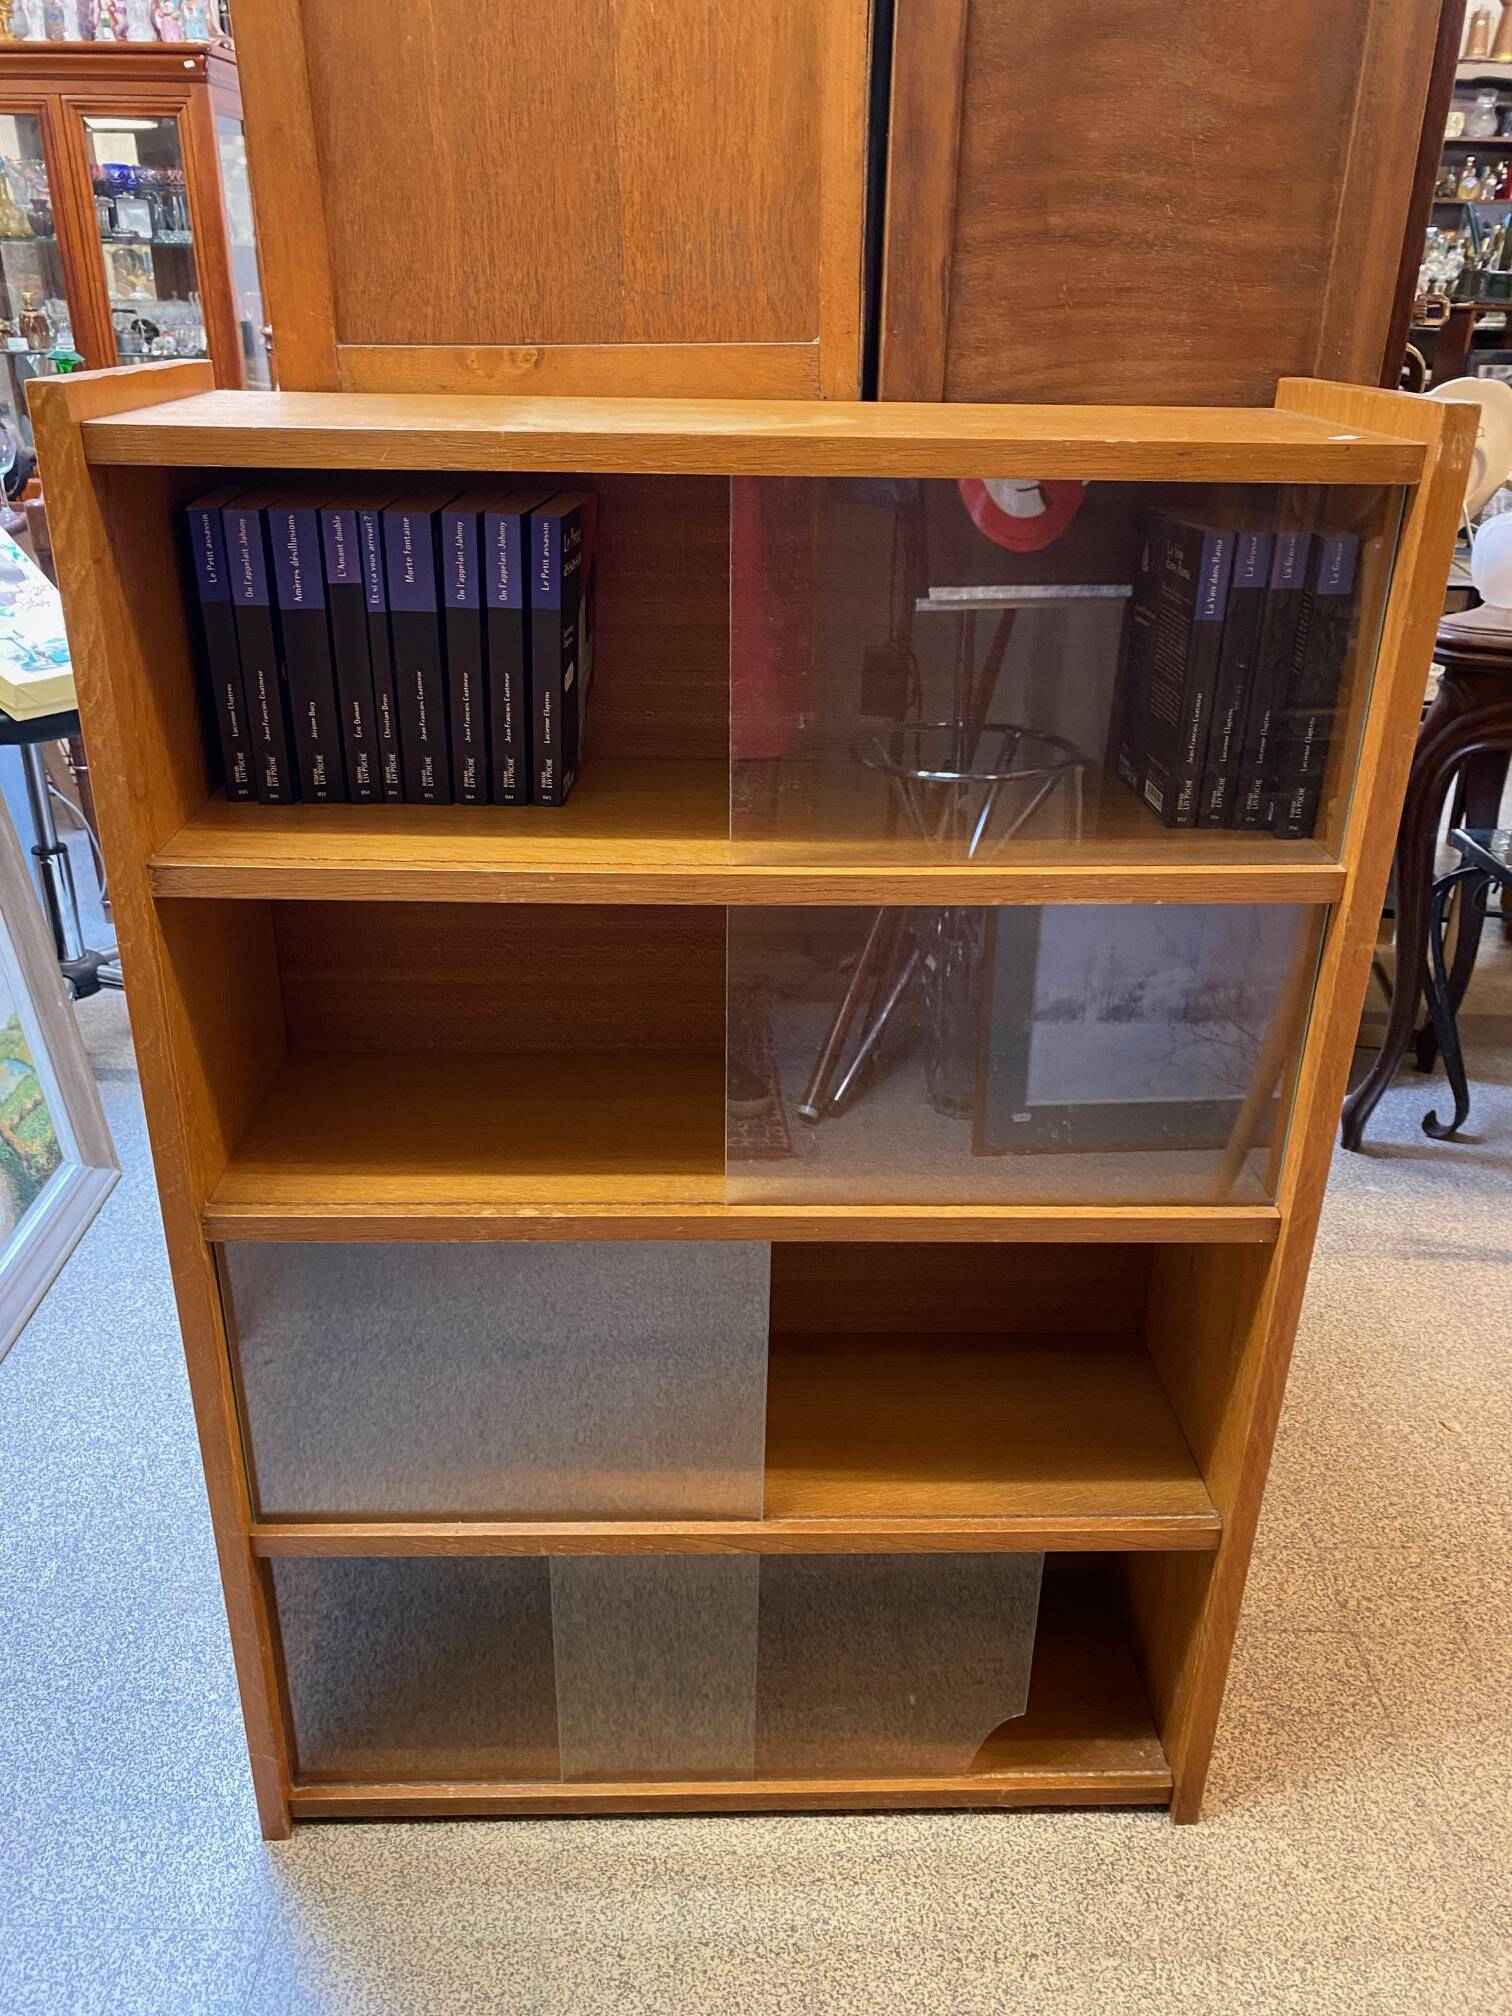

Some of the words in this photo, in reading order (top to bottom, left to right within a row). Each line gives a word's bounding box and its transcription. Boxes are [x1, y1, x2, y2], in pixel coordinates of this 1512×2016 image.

[239, 519, 248, 546] Johnny
[332, 516, 343, 541] double
[366, 523, 374, 551] arrivait
[455, 521, 464, 549] Johnny
[498, 522, 507, 549] Johnny
[288, 515, 299, 566] désillusions
[206, 551, 215, 570] Petit
[242, 549, 253, 584] l'appelait
[337, 544, 346, 576] L'Amant
[541, 560, 549, 578] Petit
[209, 574, 217, 582] Le
[370, 574, 378, 582] ça
[405, 557, 414, 582] Morte
[456, 552, 466, 587] l'appelait
[499, 552, 508, 587] l'appelait
[1210, 565, 1219, 583] dans
[1245, 567, 1254, 576] La
[1282, 568, 1292, 578] La
[1330, 573, 1339, 583] La
[244, 587, 253, 598] On
[293, 569, 302, 601] Amères
[541, 581, 549, 590] Le
[1207, 586, 1216, 602] Voix
[370, 595, 379, 603] Et
[457, 590, 465, 599] On
[499, 590, 507, 600] On
[1205, 604, 1214, 614] La
